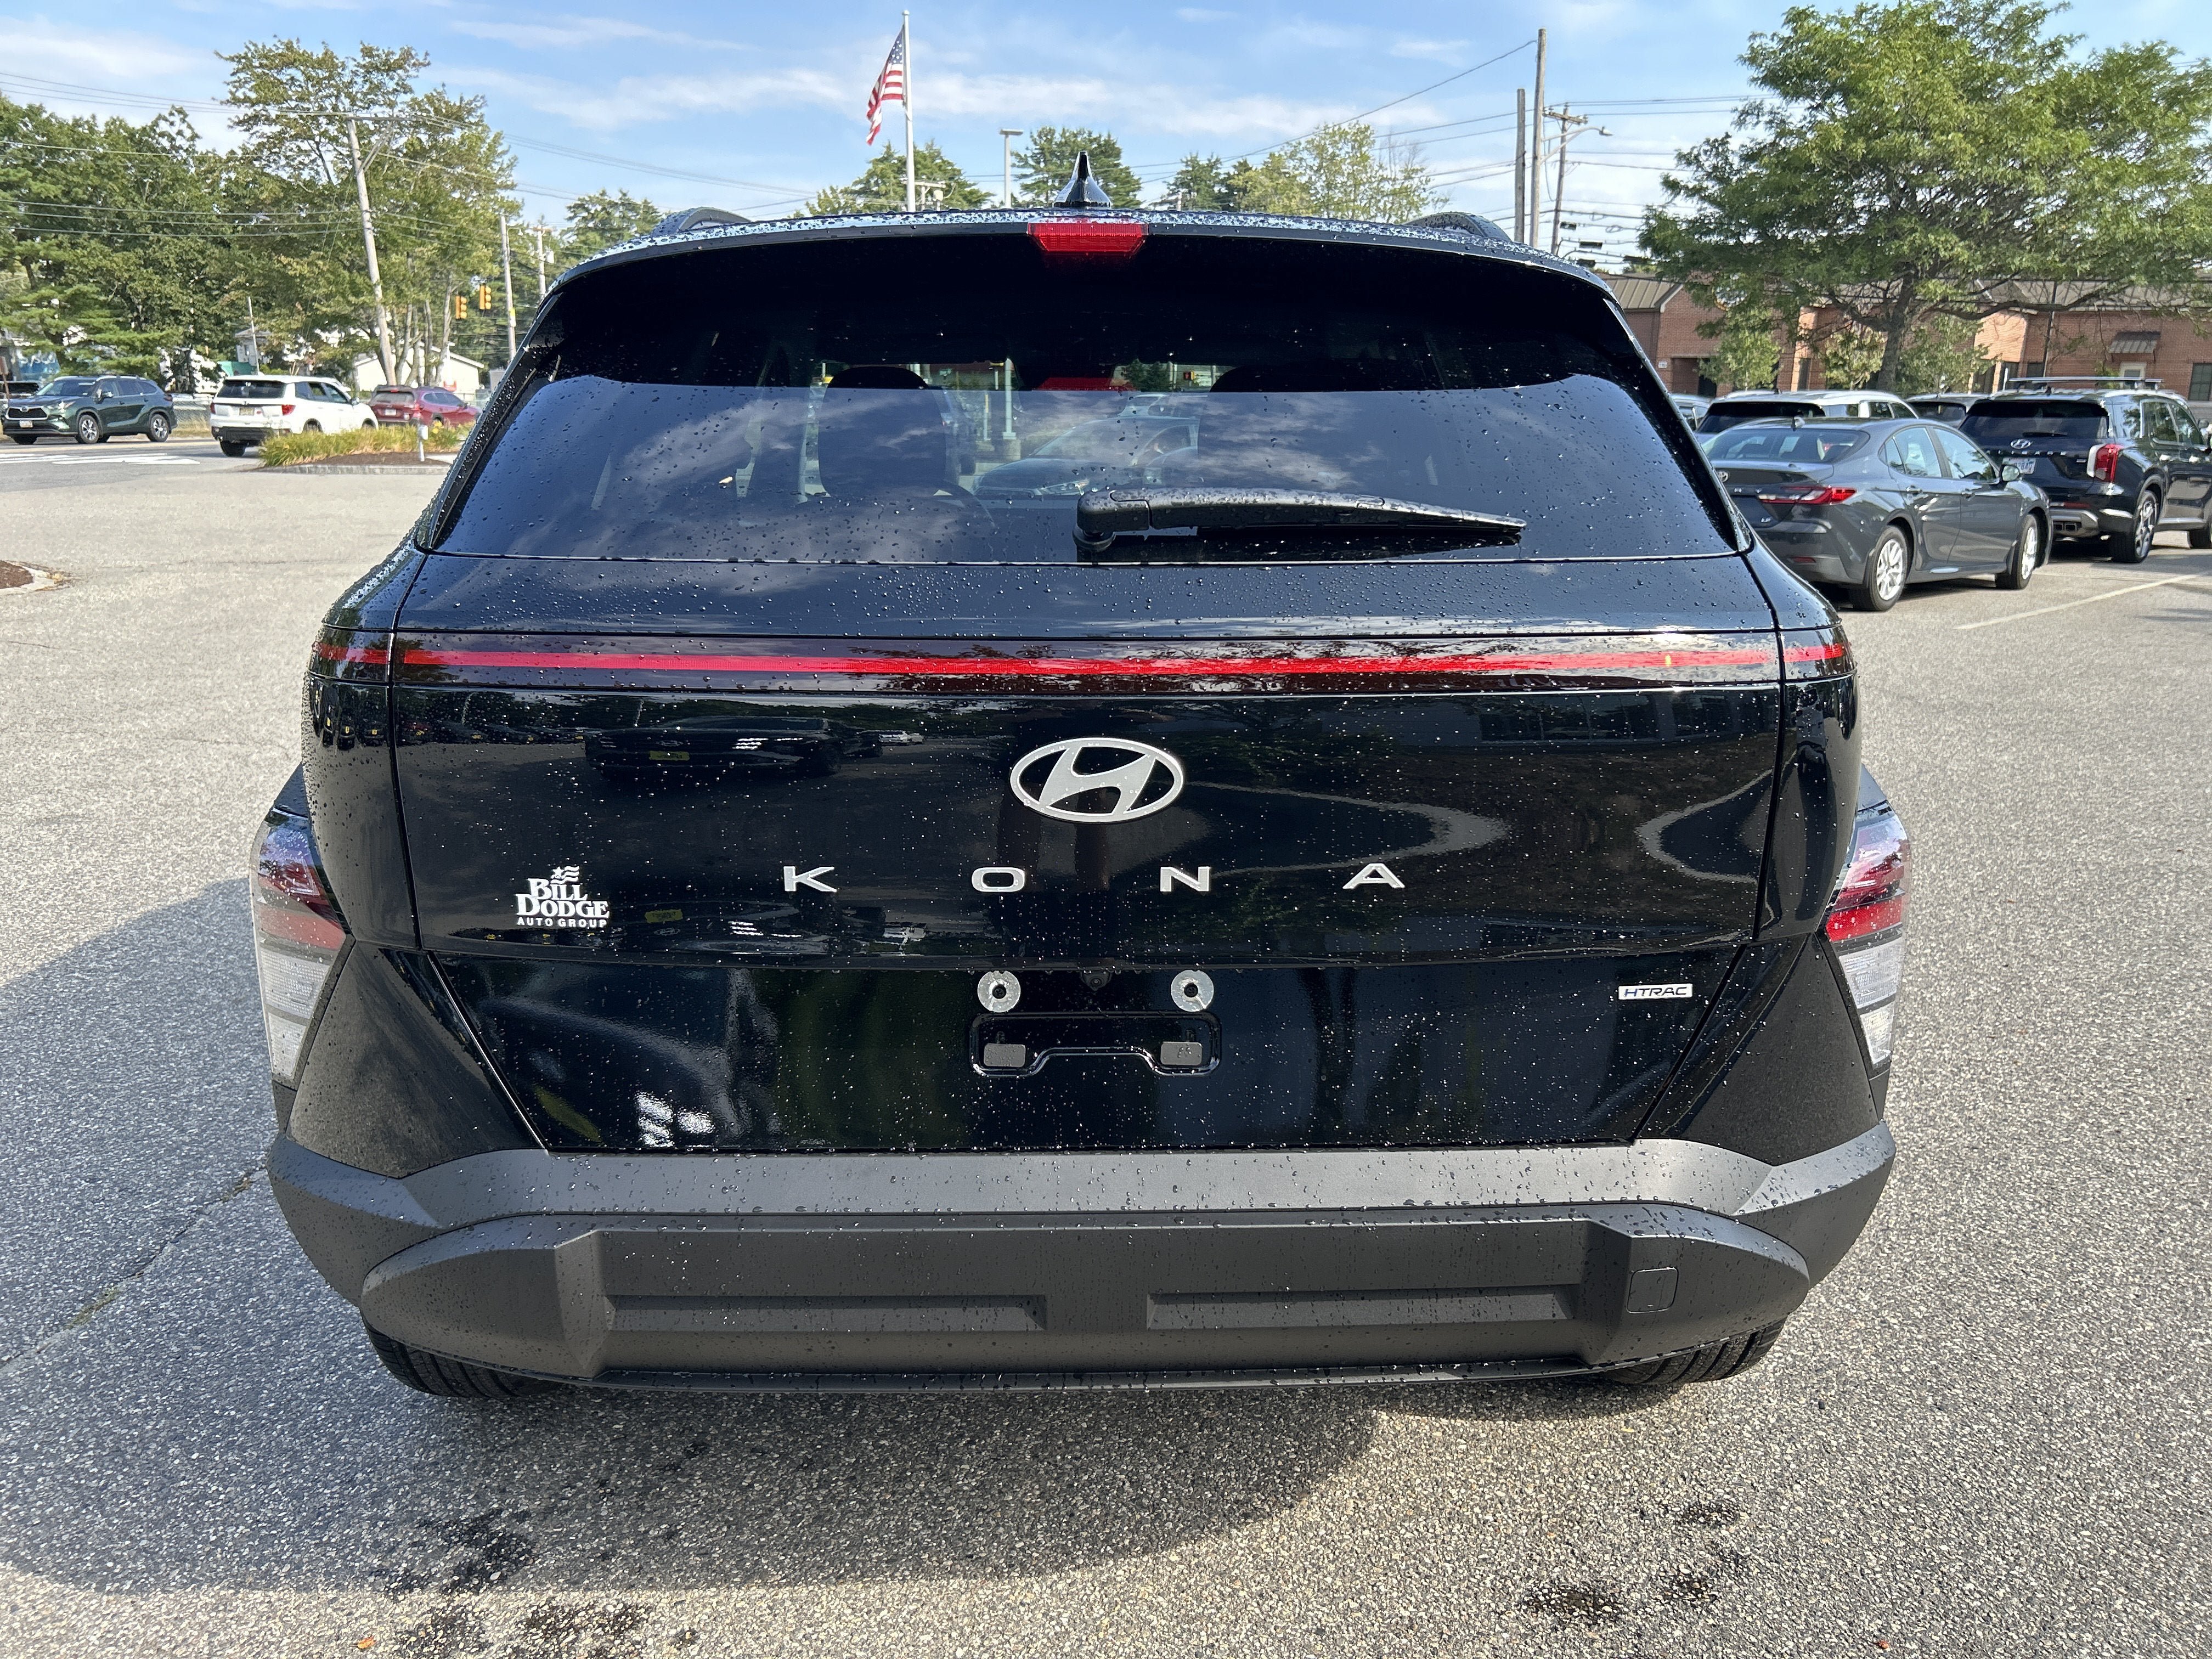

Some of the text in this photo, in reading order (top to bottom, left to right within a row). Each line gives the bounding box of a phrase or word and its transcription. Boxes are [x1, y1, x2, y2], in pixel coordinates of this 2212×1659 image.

[527, 878, 588, 900] BILL
[783, 863, 1406, 893] KONA
[515, 894, 610, 918] DODGE
[517, 917, 607, 928] AUTO GROUP
[1624, 986, 1687, 997] HTRAC
